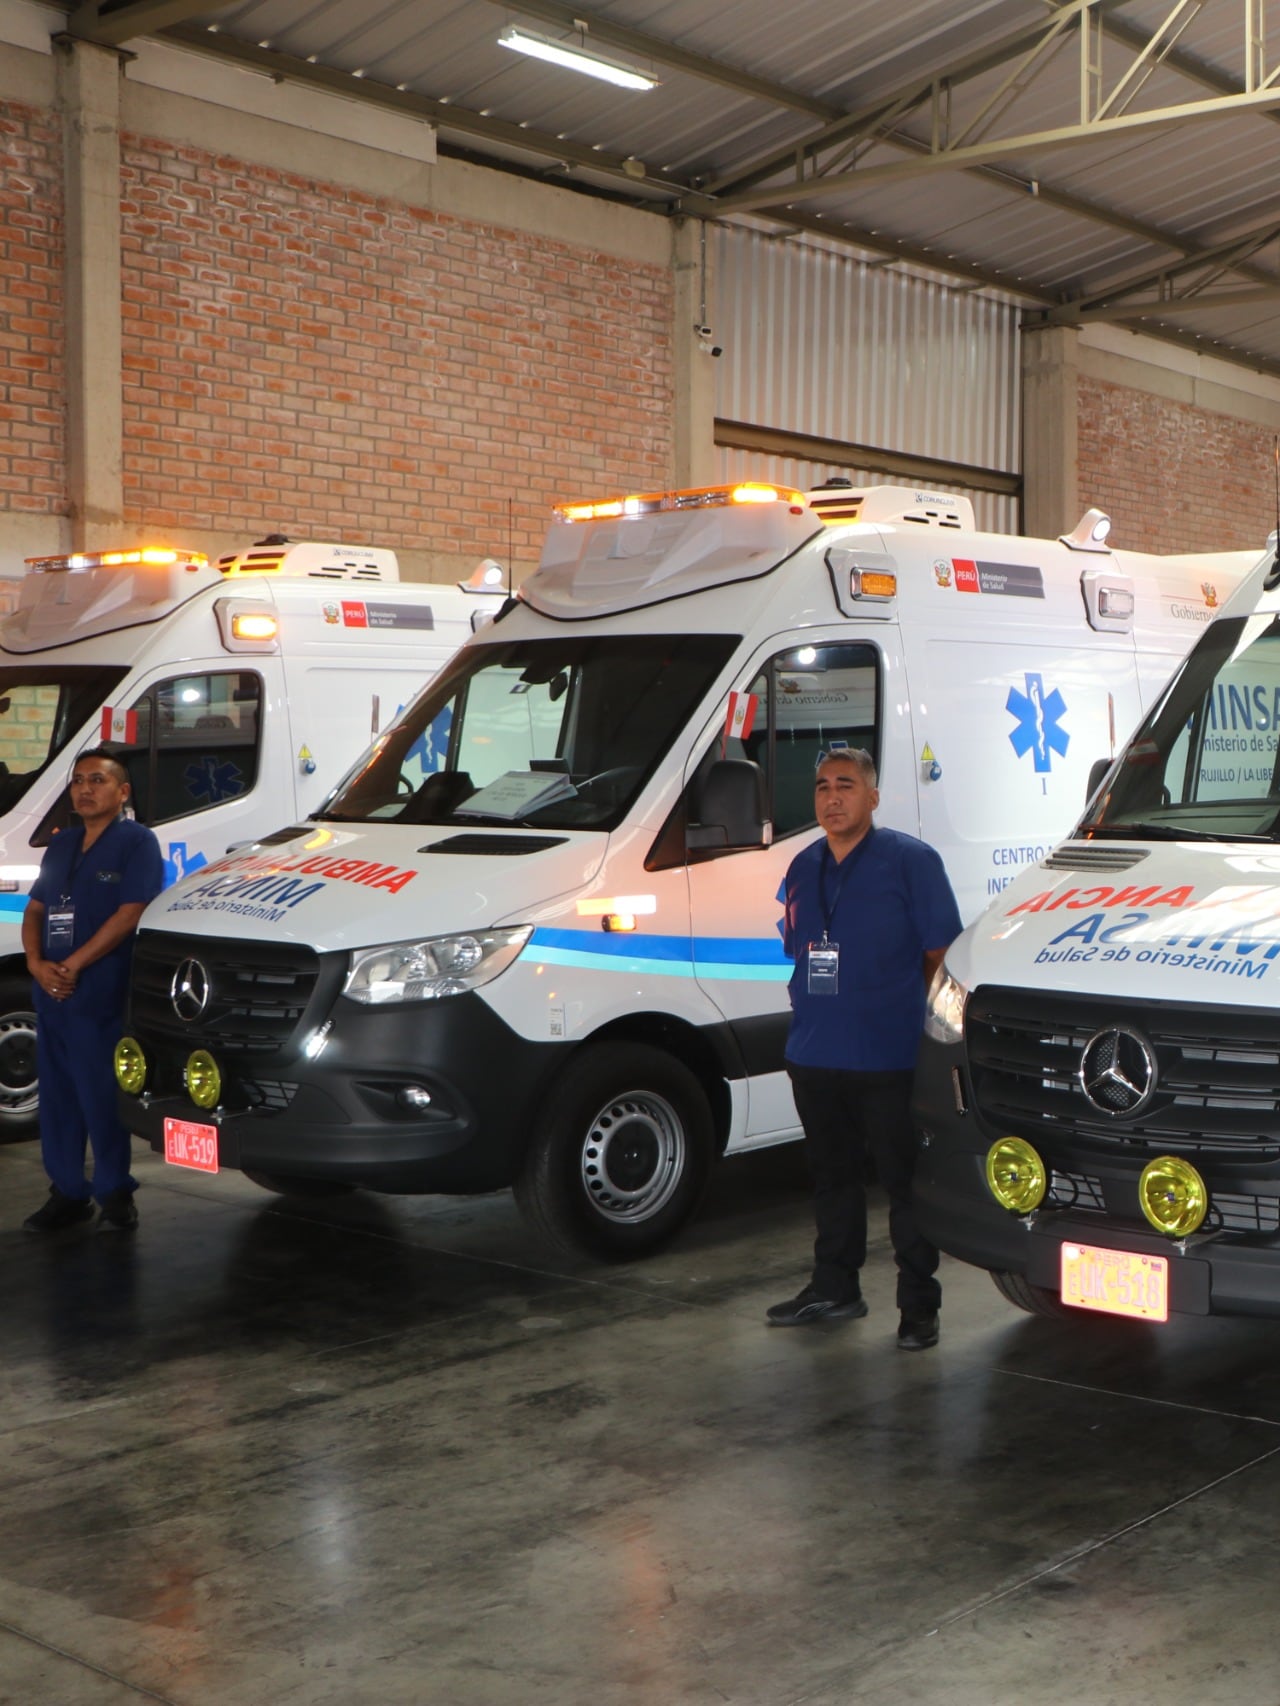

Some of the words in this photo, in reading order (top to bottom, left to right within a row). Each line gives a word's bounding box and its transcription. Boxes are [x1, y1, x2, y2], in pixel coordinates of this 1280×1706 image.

[957, 570, 976, 582] PERÚ
[981, 572, 1008, 583] Ministerio
[982, 581, 990, 590] de
[990, 582, 1005, 591] Salud
[1203, 735, 1248, 752] nisterio
[1250, 735, 1265, 752] de
[1244, 767, 1254, 782] LA
[1256, 767, 1273, 781] LIBE
[992, 846, 1045, 866] CENTRO
[987, 876, 1015, 896] INF
